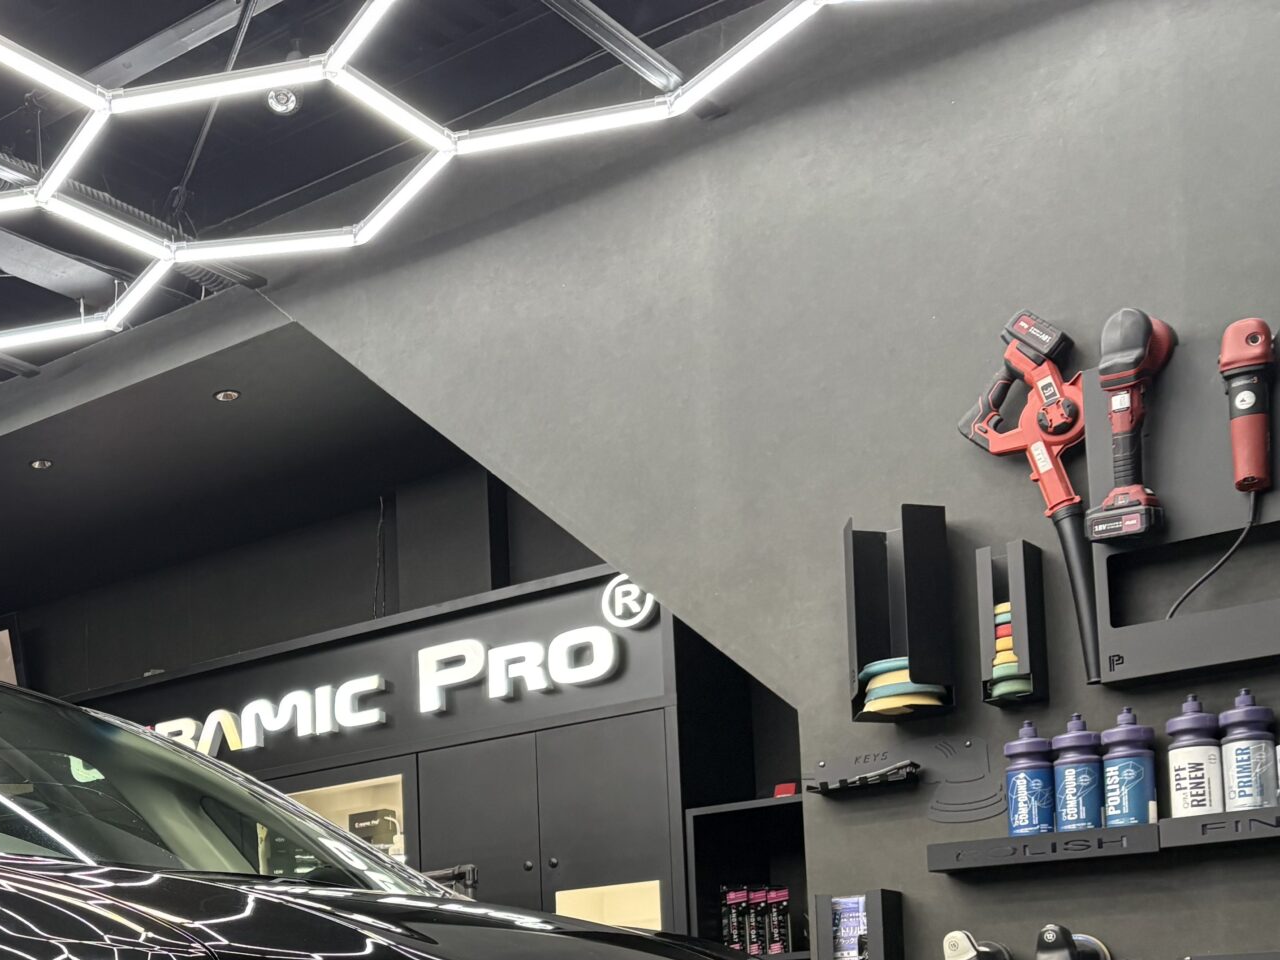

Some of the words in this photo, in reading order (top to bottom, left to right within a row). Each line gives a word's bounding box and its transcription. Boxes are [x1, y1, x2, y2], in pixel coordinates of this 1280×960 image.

[854, 751, 889, 765] KEYS
[1174, 765, 1187, 792] PPF
[1234, 746, 1253, 799] PRIMER
[1065, 768, 1078, 821] COMPOUND
[1106, 766, 1121, 816] POLISH
[1188, 762, 1207, 808] RENEW
